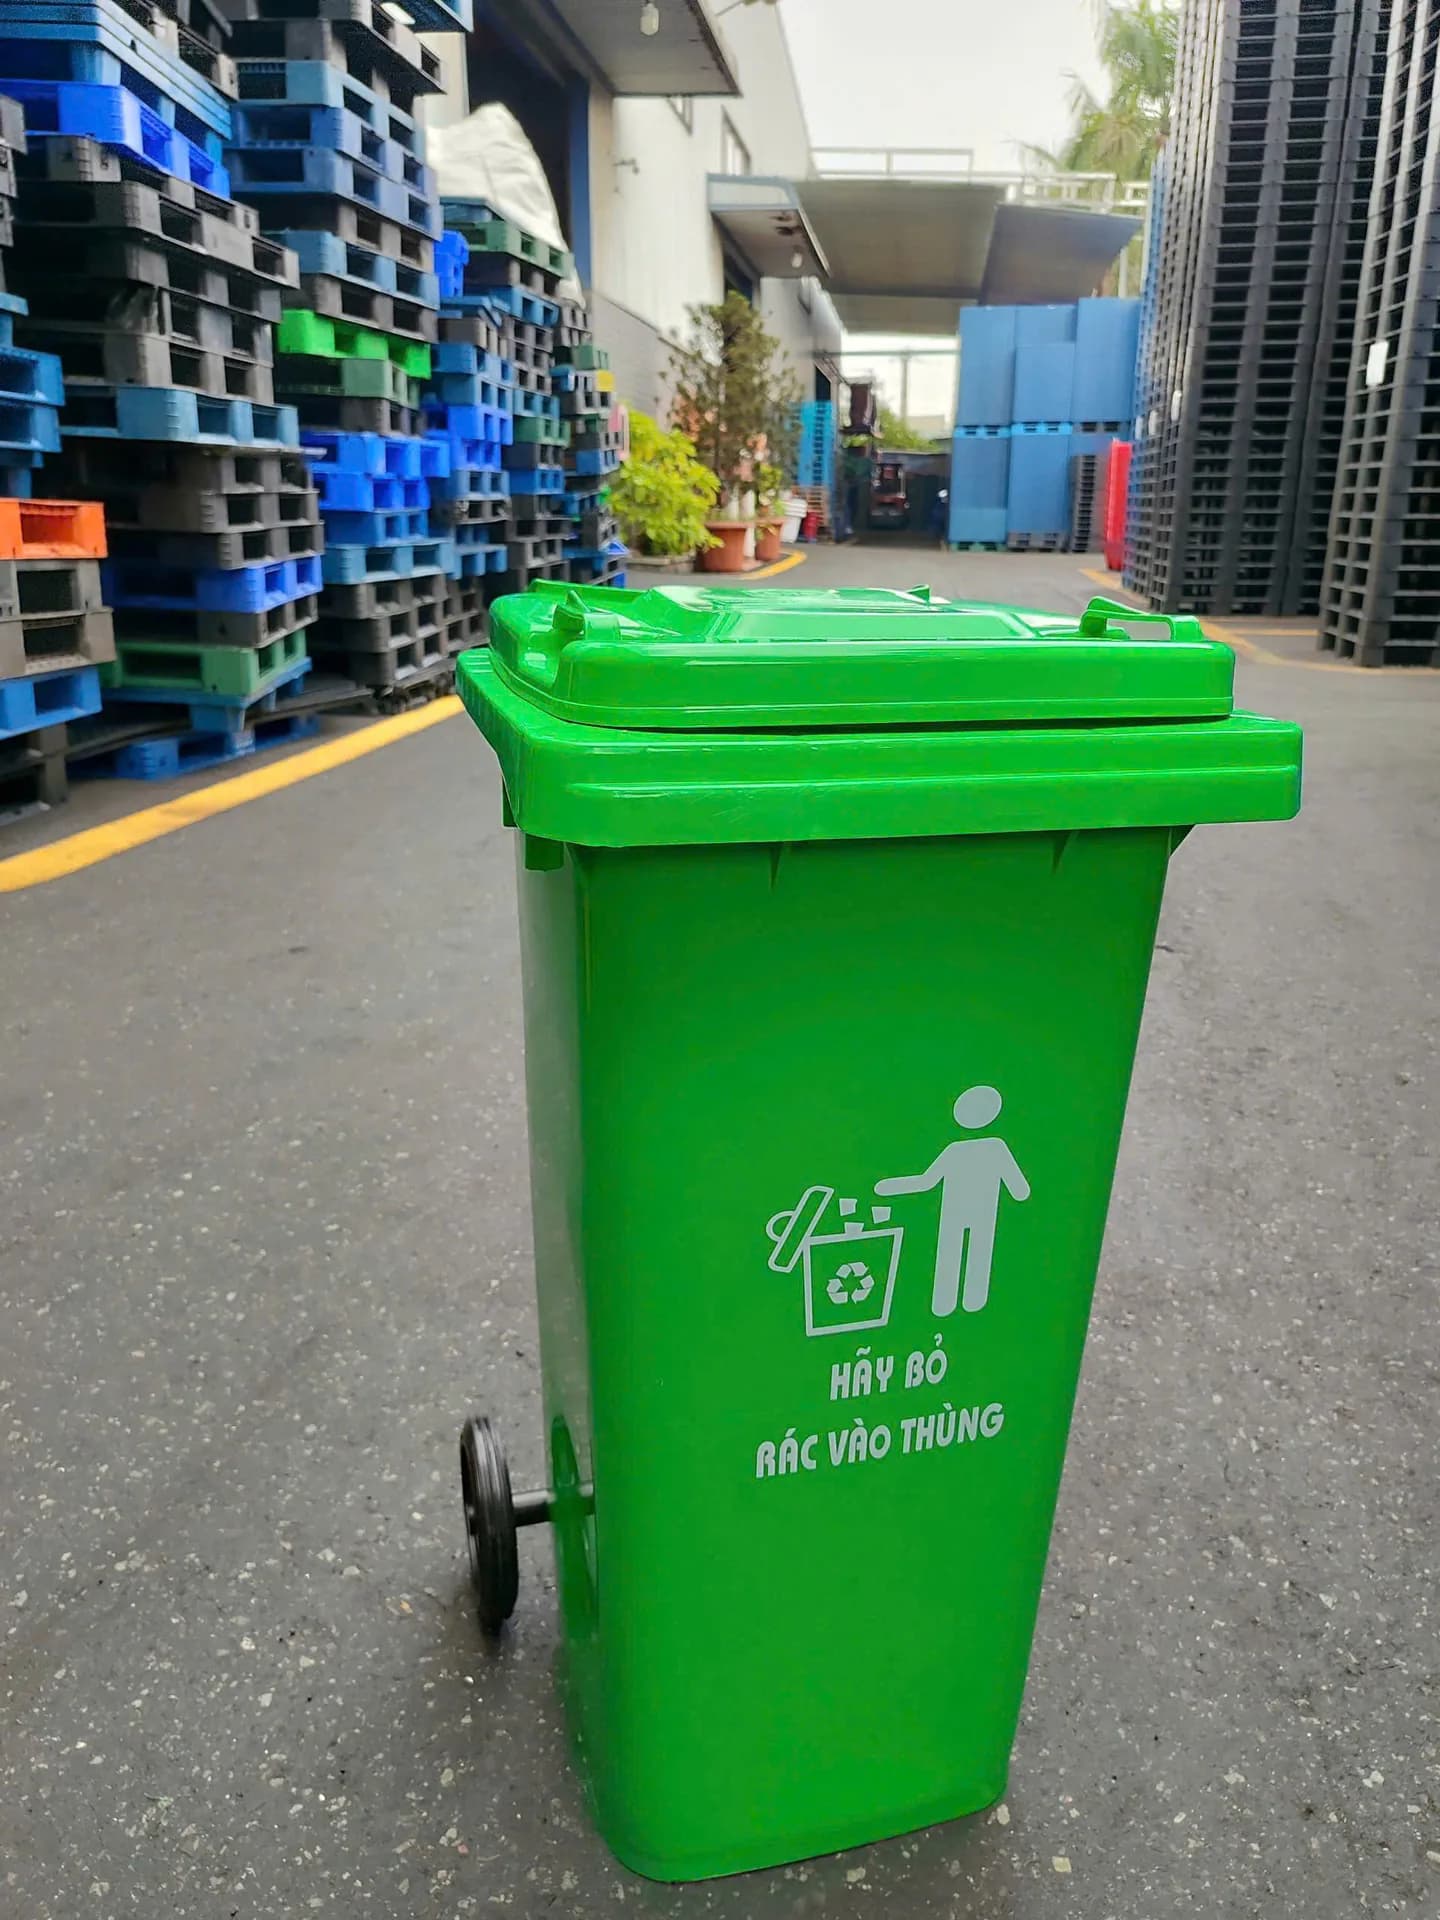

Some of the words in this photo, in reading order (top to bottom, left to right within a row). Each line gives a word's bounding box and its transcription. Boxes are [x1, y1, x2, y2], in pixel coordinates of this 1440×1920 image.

[830, 1346, 894, 1401] HÃY
[904, 1333, 948, 1388] BỎ
[756, 1427, 818, 1478] RÁC
[828, 1417, 891, 1466] VÀO
[900, 1402, 1005, 1453] THÙNG
